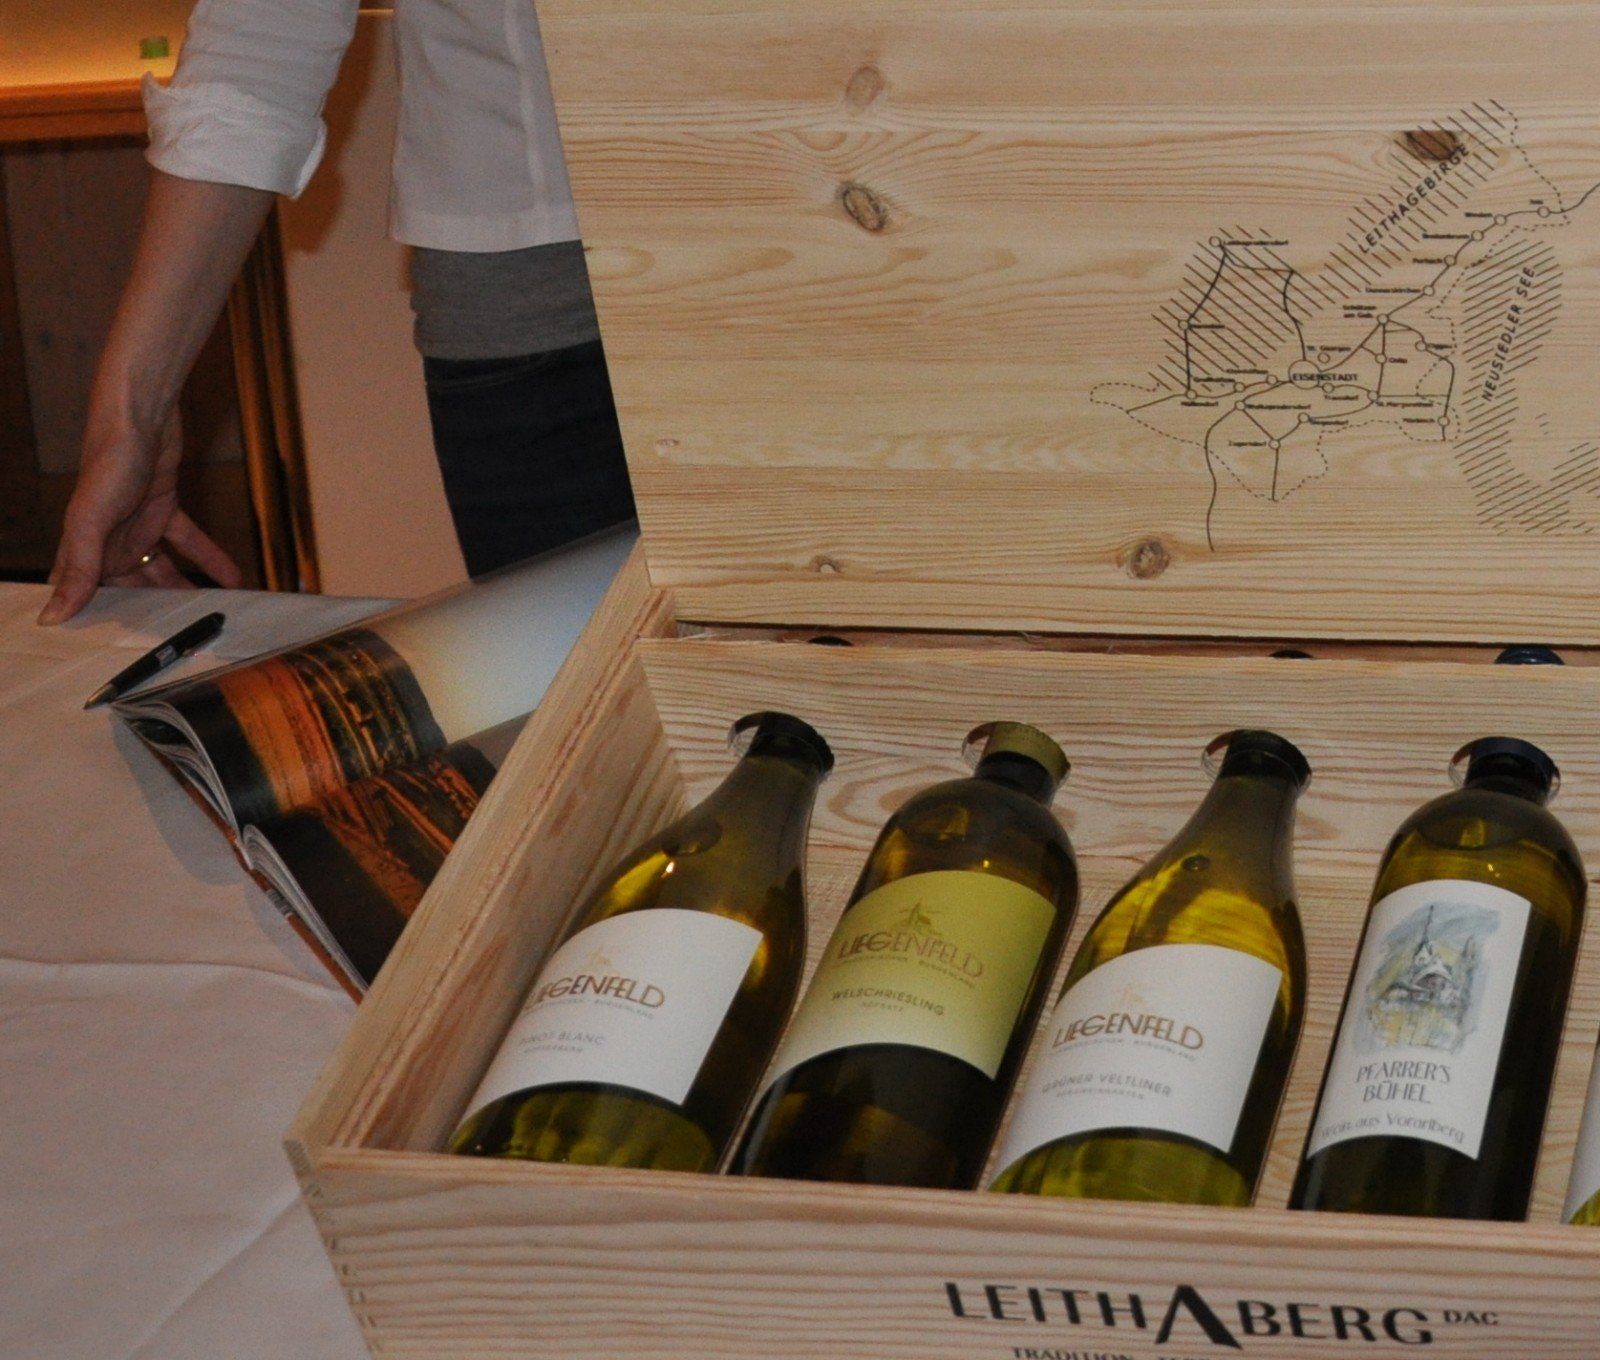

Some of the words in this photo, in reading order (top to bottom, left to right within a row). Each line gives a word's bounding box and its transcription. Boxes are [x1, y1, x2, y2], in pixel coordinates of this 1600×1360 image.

[1357, 143, 1469, 254] LEITHAGEBIRGE
[1481, 304, 1523, 402] NEUSIEDLER
[1516, 266, 1535, 298] SEE
[1292, 372, 1359, 382] EISENSTADT
[837, 931, 984, 978] LIEGENFELD
[832, 988, 945, 1016] WELSCHRIESLING
[1052, 1012, 1204, 1051] LIEGENFELD
[1099, 1072, 1172, 1098] VELTLINER
[1355, 1060, 1452, 1084] PFARRER'S
[1386, 1112, 1465, 1144] Vorarlberg
[945, 1282, 1434, 1350] LEITHABERG
[1443, 1308, 1501, 1327] DAC
